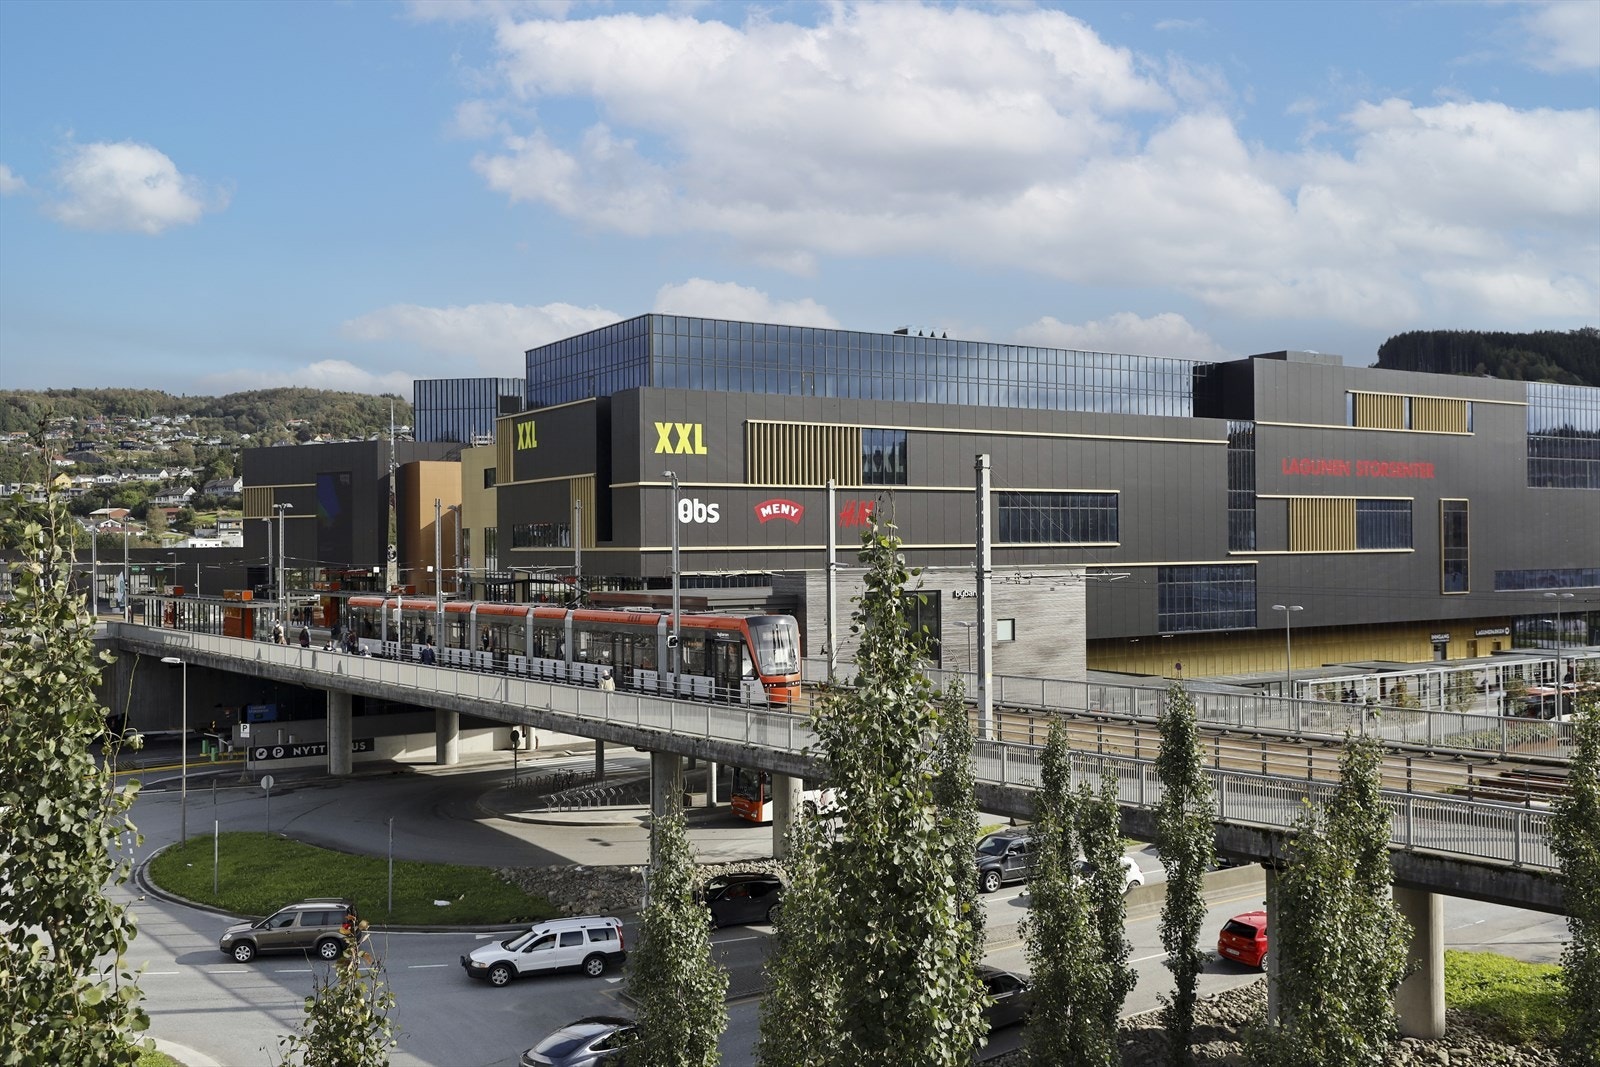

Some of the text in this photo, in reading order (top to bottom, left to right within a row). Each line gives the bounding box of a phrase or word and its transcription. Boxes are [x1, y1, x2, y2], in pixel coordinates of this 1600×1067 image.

[517, 420, 538, 450] XXL
[654, 421, 708, 455] XXL
[1281, 457, 1351, 477] LAGUNEN
[678, 498, 720, 524] Obs
[760, 503, 800, 518] MENY
[955, 589, 978, 598] byban
[242, 724, 248, 732] P
[293, 744, 326, 756] NYTT
